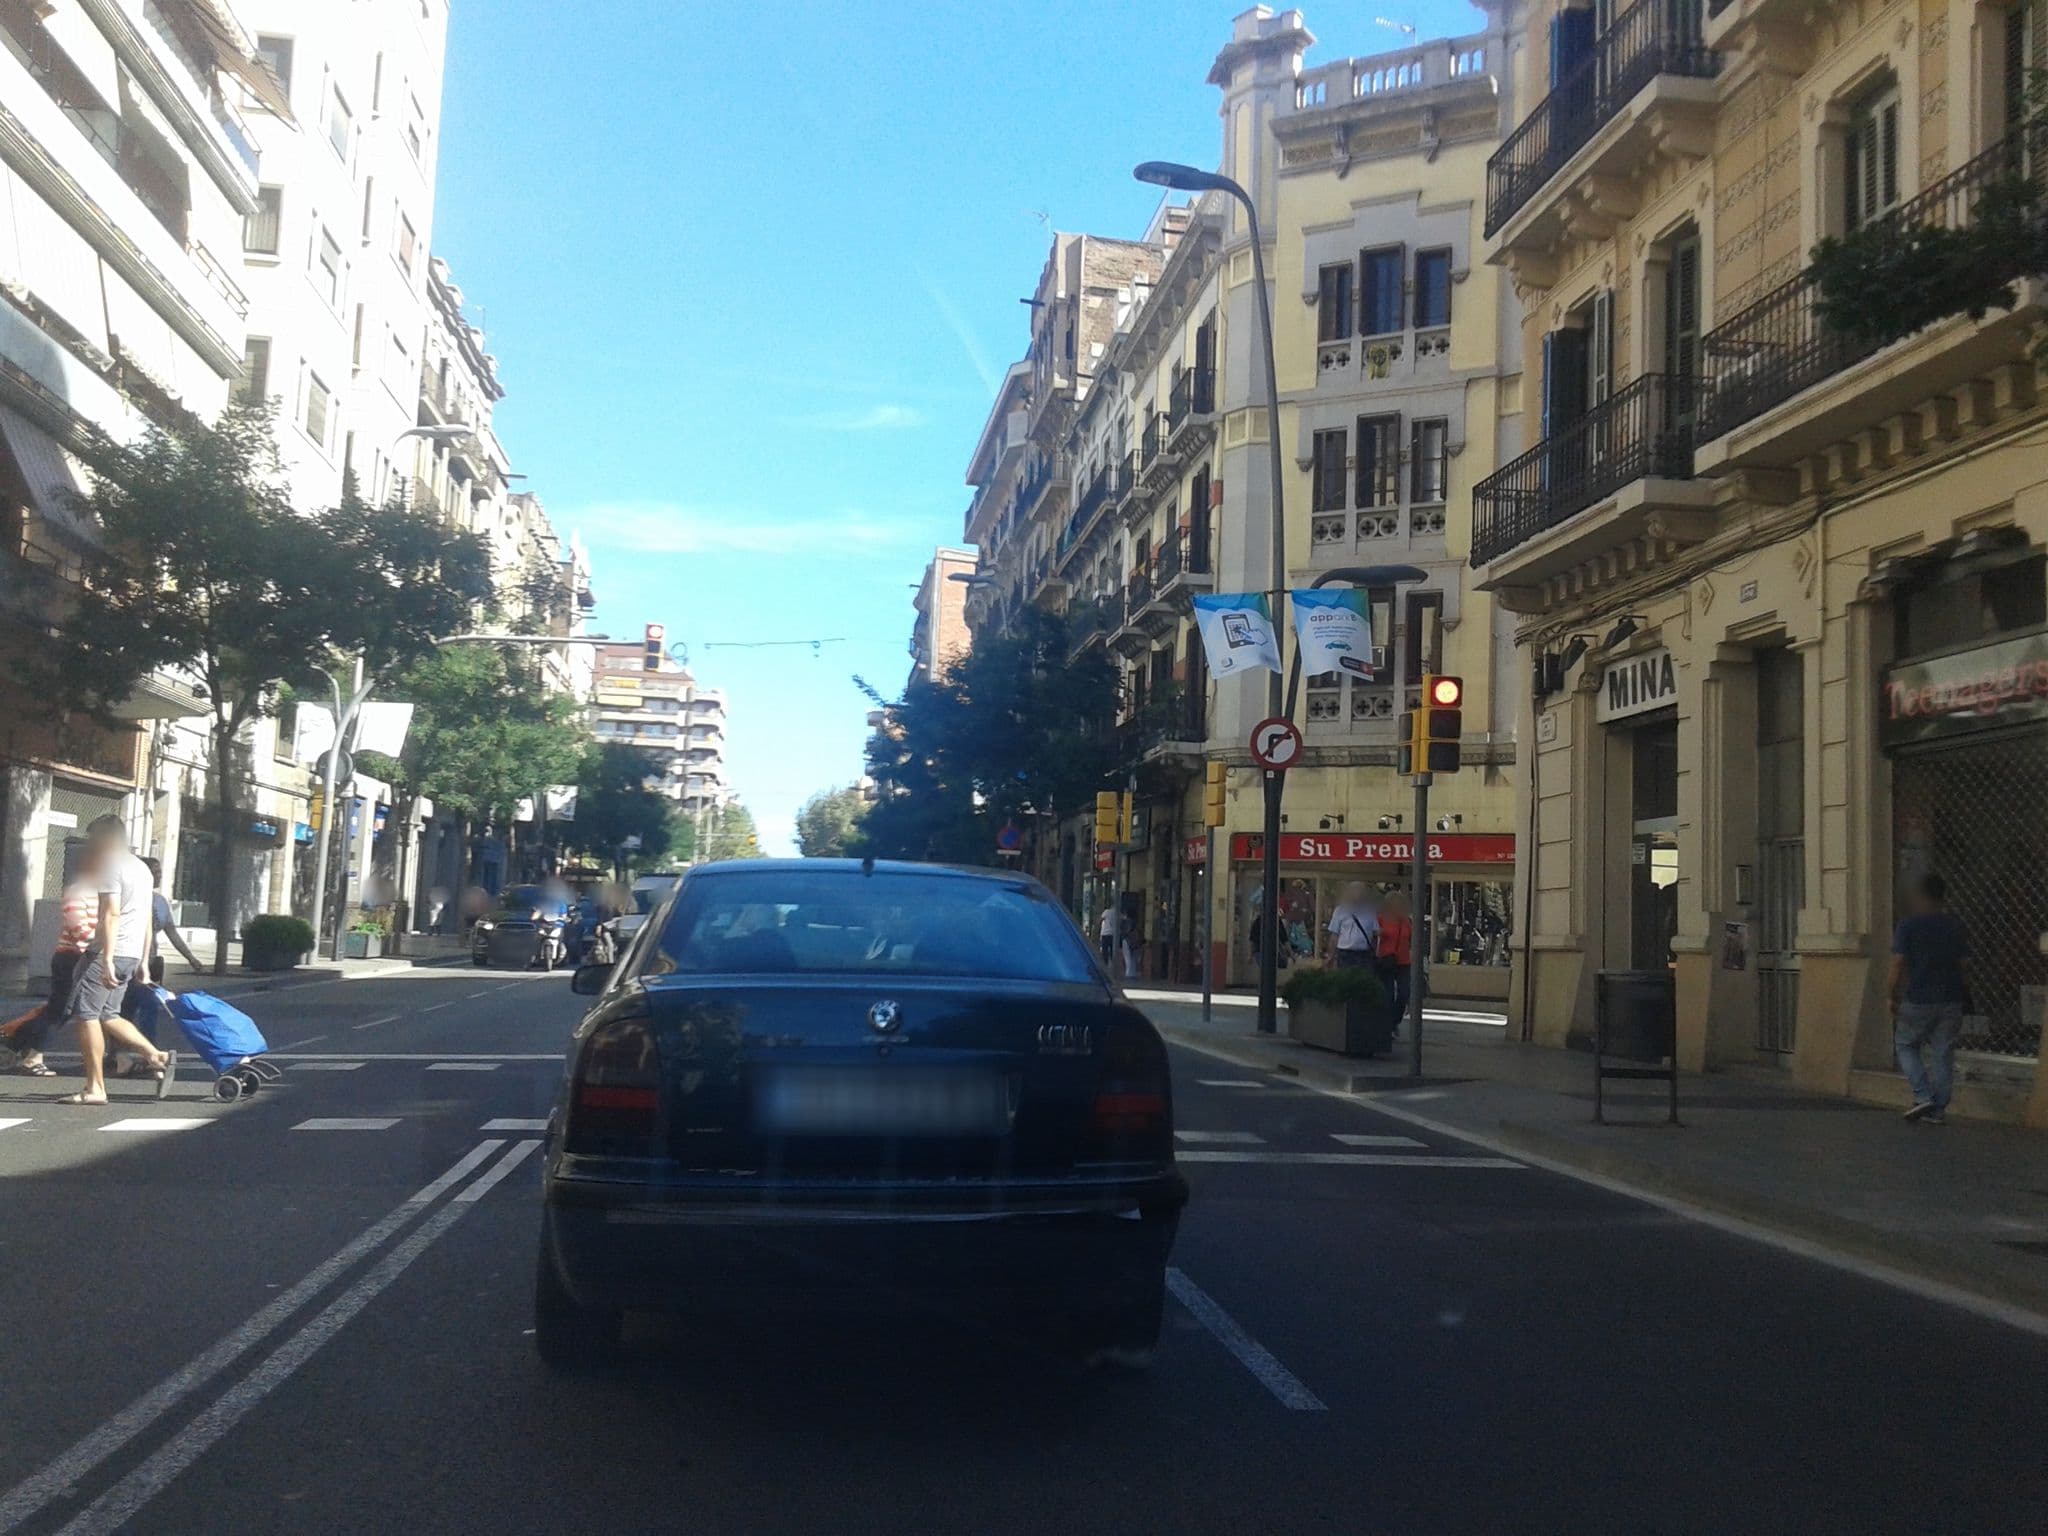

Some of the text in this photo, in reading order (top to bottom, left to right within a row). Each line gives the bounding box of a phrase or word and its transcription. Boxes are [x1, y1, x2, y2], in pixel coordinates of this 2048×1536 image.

[1609, 653, 1676, 710] MINA
[1300, 838, 1444, 858] Su Prena
